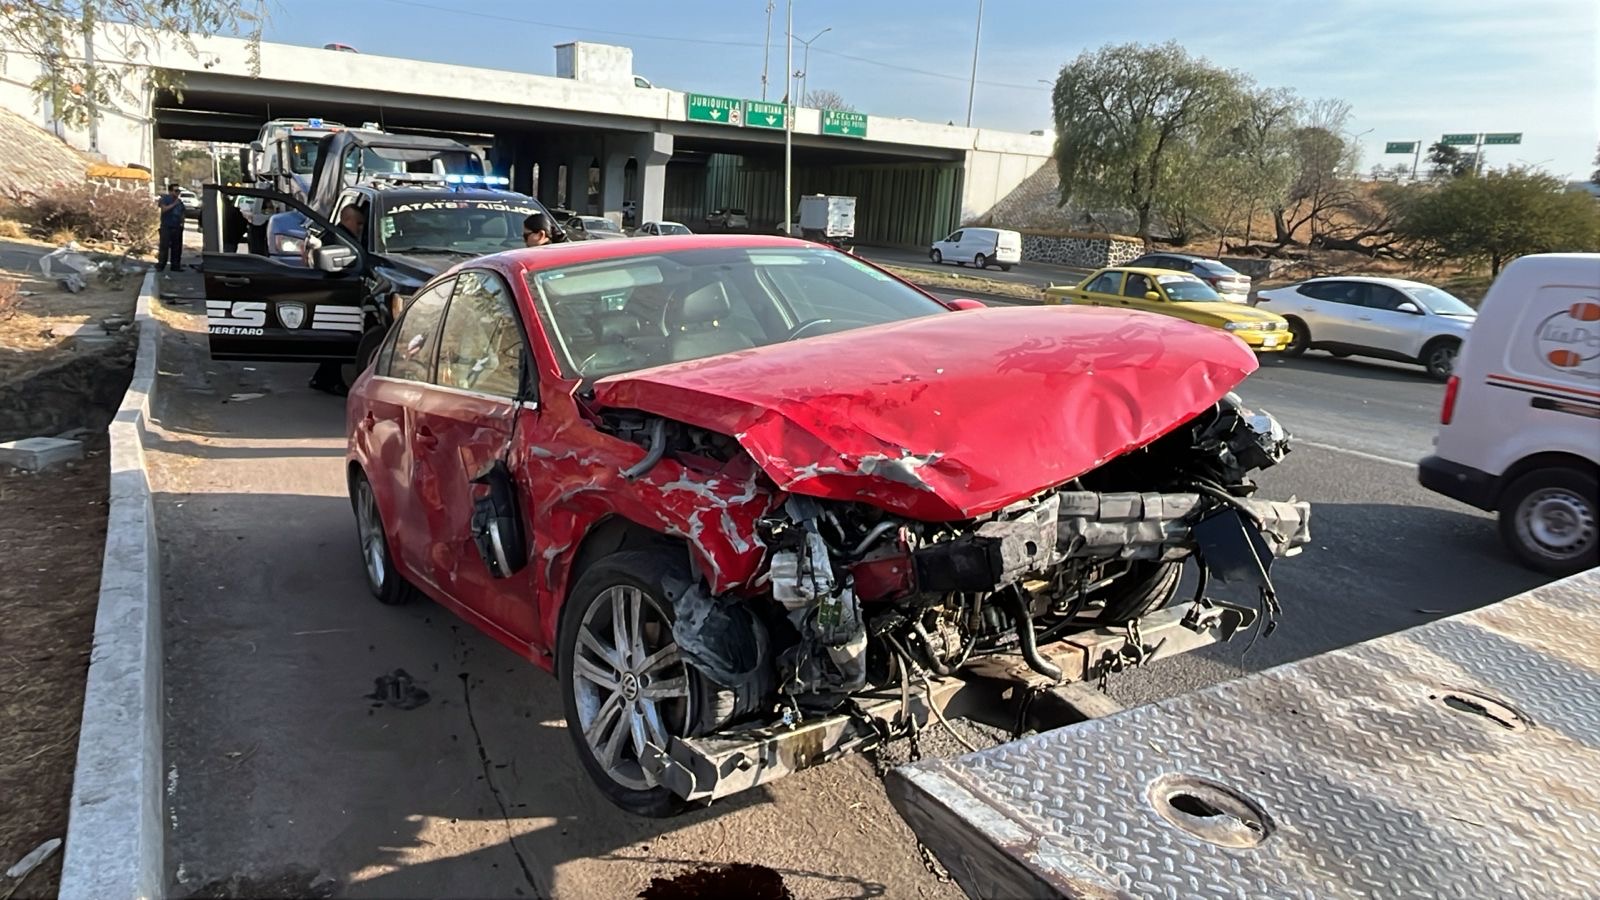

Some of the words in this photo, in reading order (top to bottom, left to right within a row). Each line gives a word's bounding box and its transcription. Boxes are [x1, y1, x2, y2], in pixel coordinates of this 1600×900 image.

[692, 96, 740, 110] JURIQUILLA
[754, 103, 782, 115] QUINTANA
[836, 112, 863, 121] CELAYA
[208, 326, 264, 336] UERÉTARO
